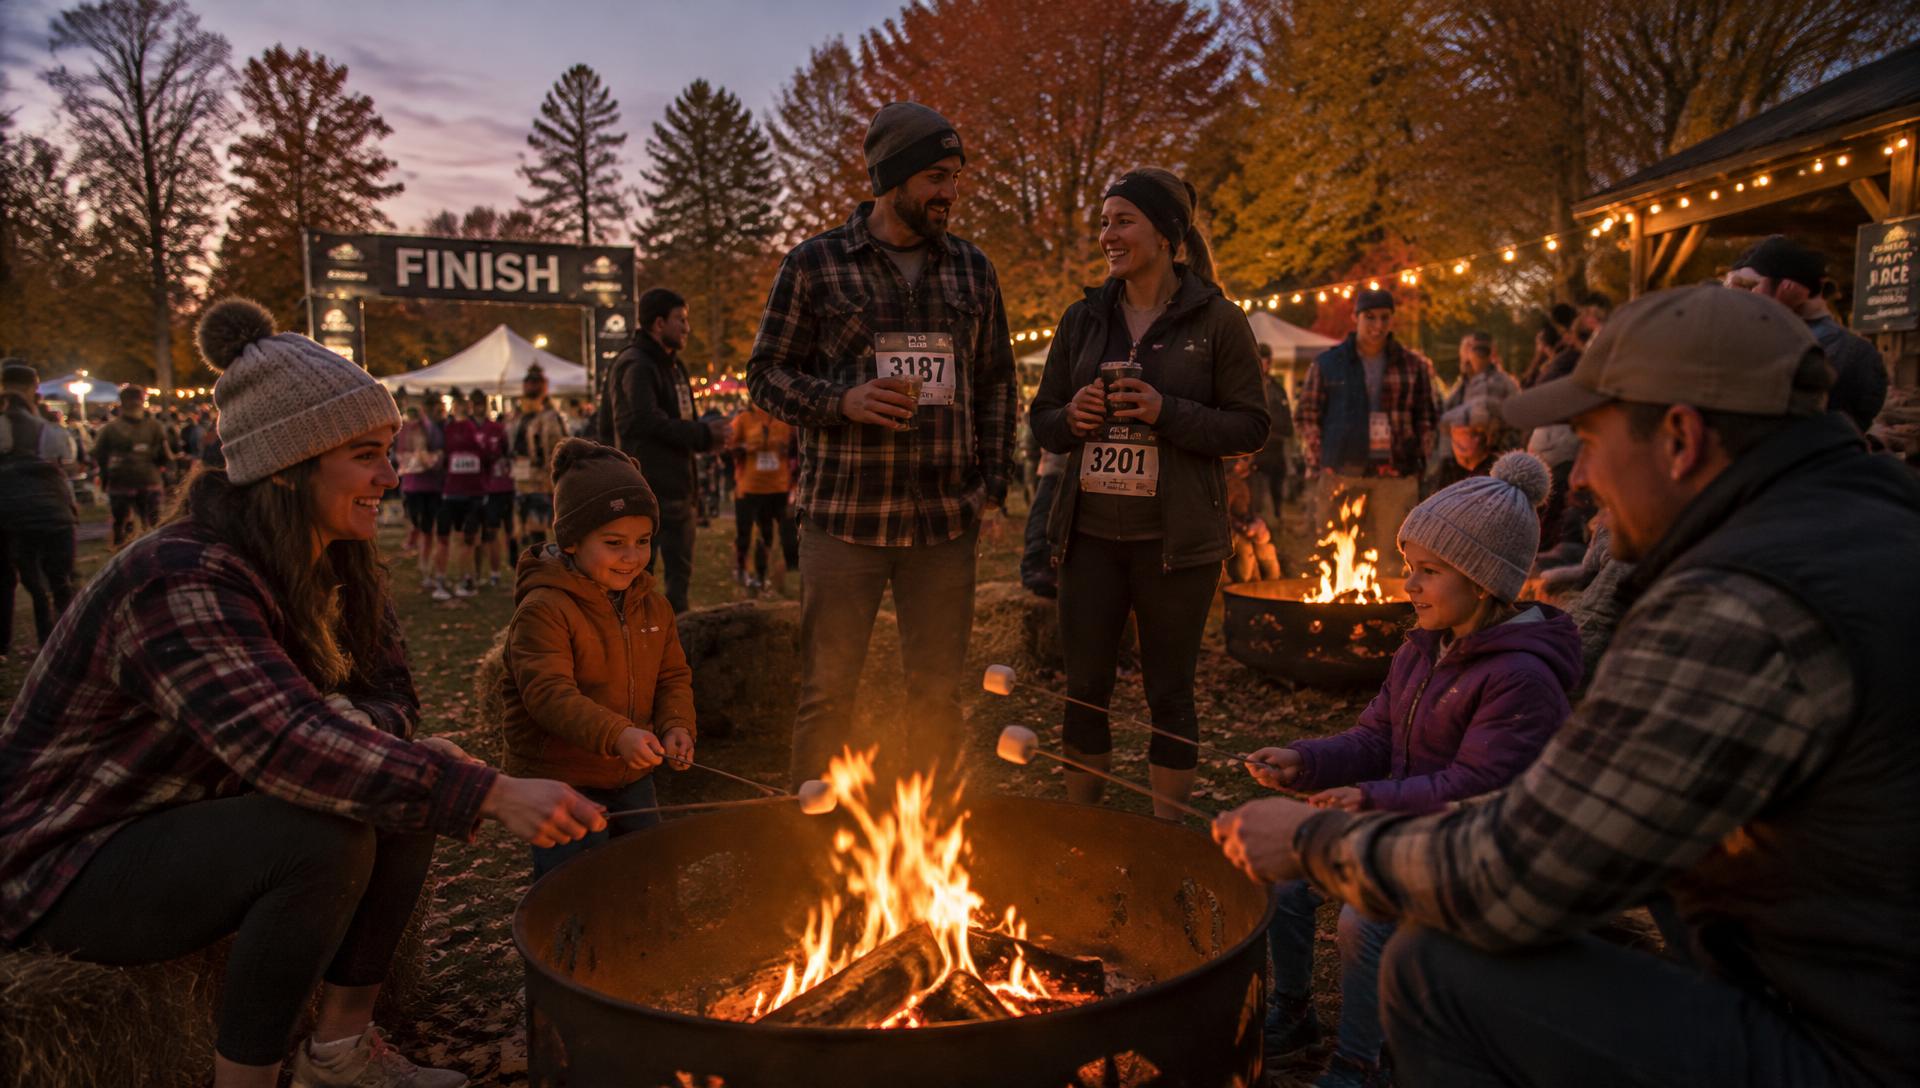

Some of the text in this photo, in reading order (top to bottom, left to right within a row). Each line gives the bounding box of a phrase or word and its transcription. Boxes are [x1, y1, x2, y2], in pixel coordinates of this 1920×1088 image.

[396, 247, 560, 294] FINISH
[889, 356, 945, 383] 3187
[1090, 446, 1146, 475] 3201
